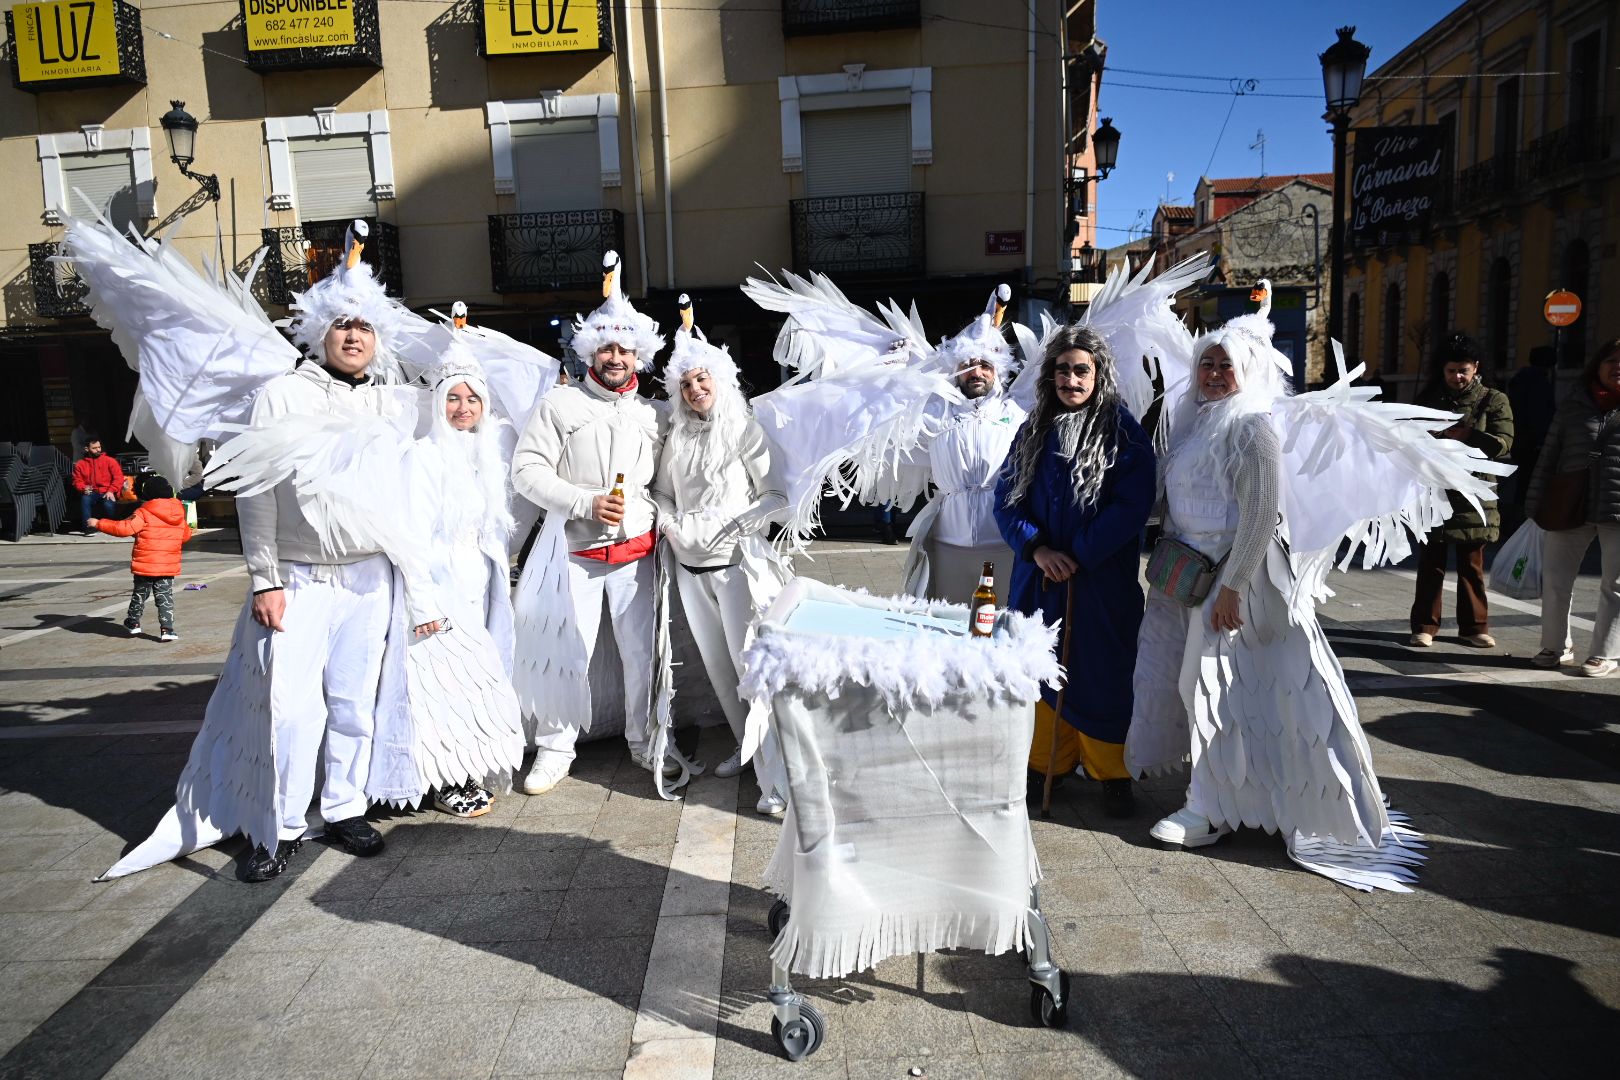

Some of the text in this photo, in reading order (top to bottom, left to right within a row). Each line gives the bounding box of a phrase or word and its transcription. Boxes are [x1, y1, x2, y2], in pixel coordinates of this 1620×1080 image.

[25, 7, 36, 41] FINCAS
[35, 1, 100, 64] LUZ
[265, 16, 334, 31] 682 477 240
[254, 32, 349, 46] www.fincasluz.com
[512, 39, 579, 49] INMOBILIARIA
[41, 65, 102, 76] INMOBILIARIA
[1374, 135, 1419, 157] Vive
[1353, 148, 1441, 198] Carnaval
[1353, 196, 1431, 230] La Bañeza
